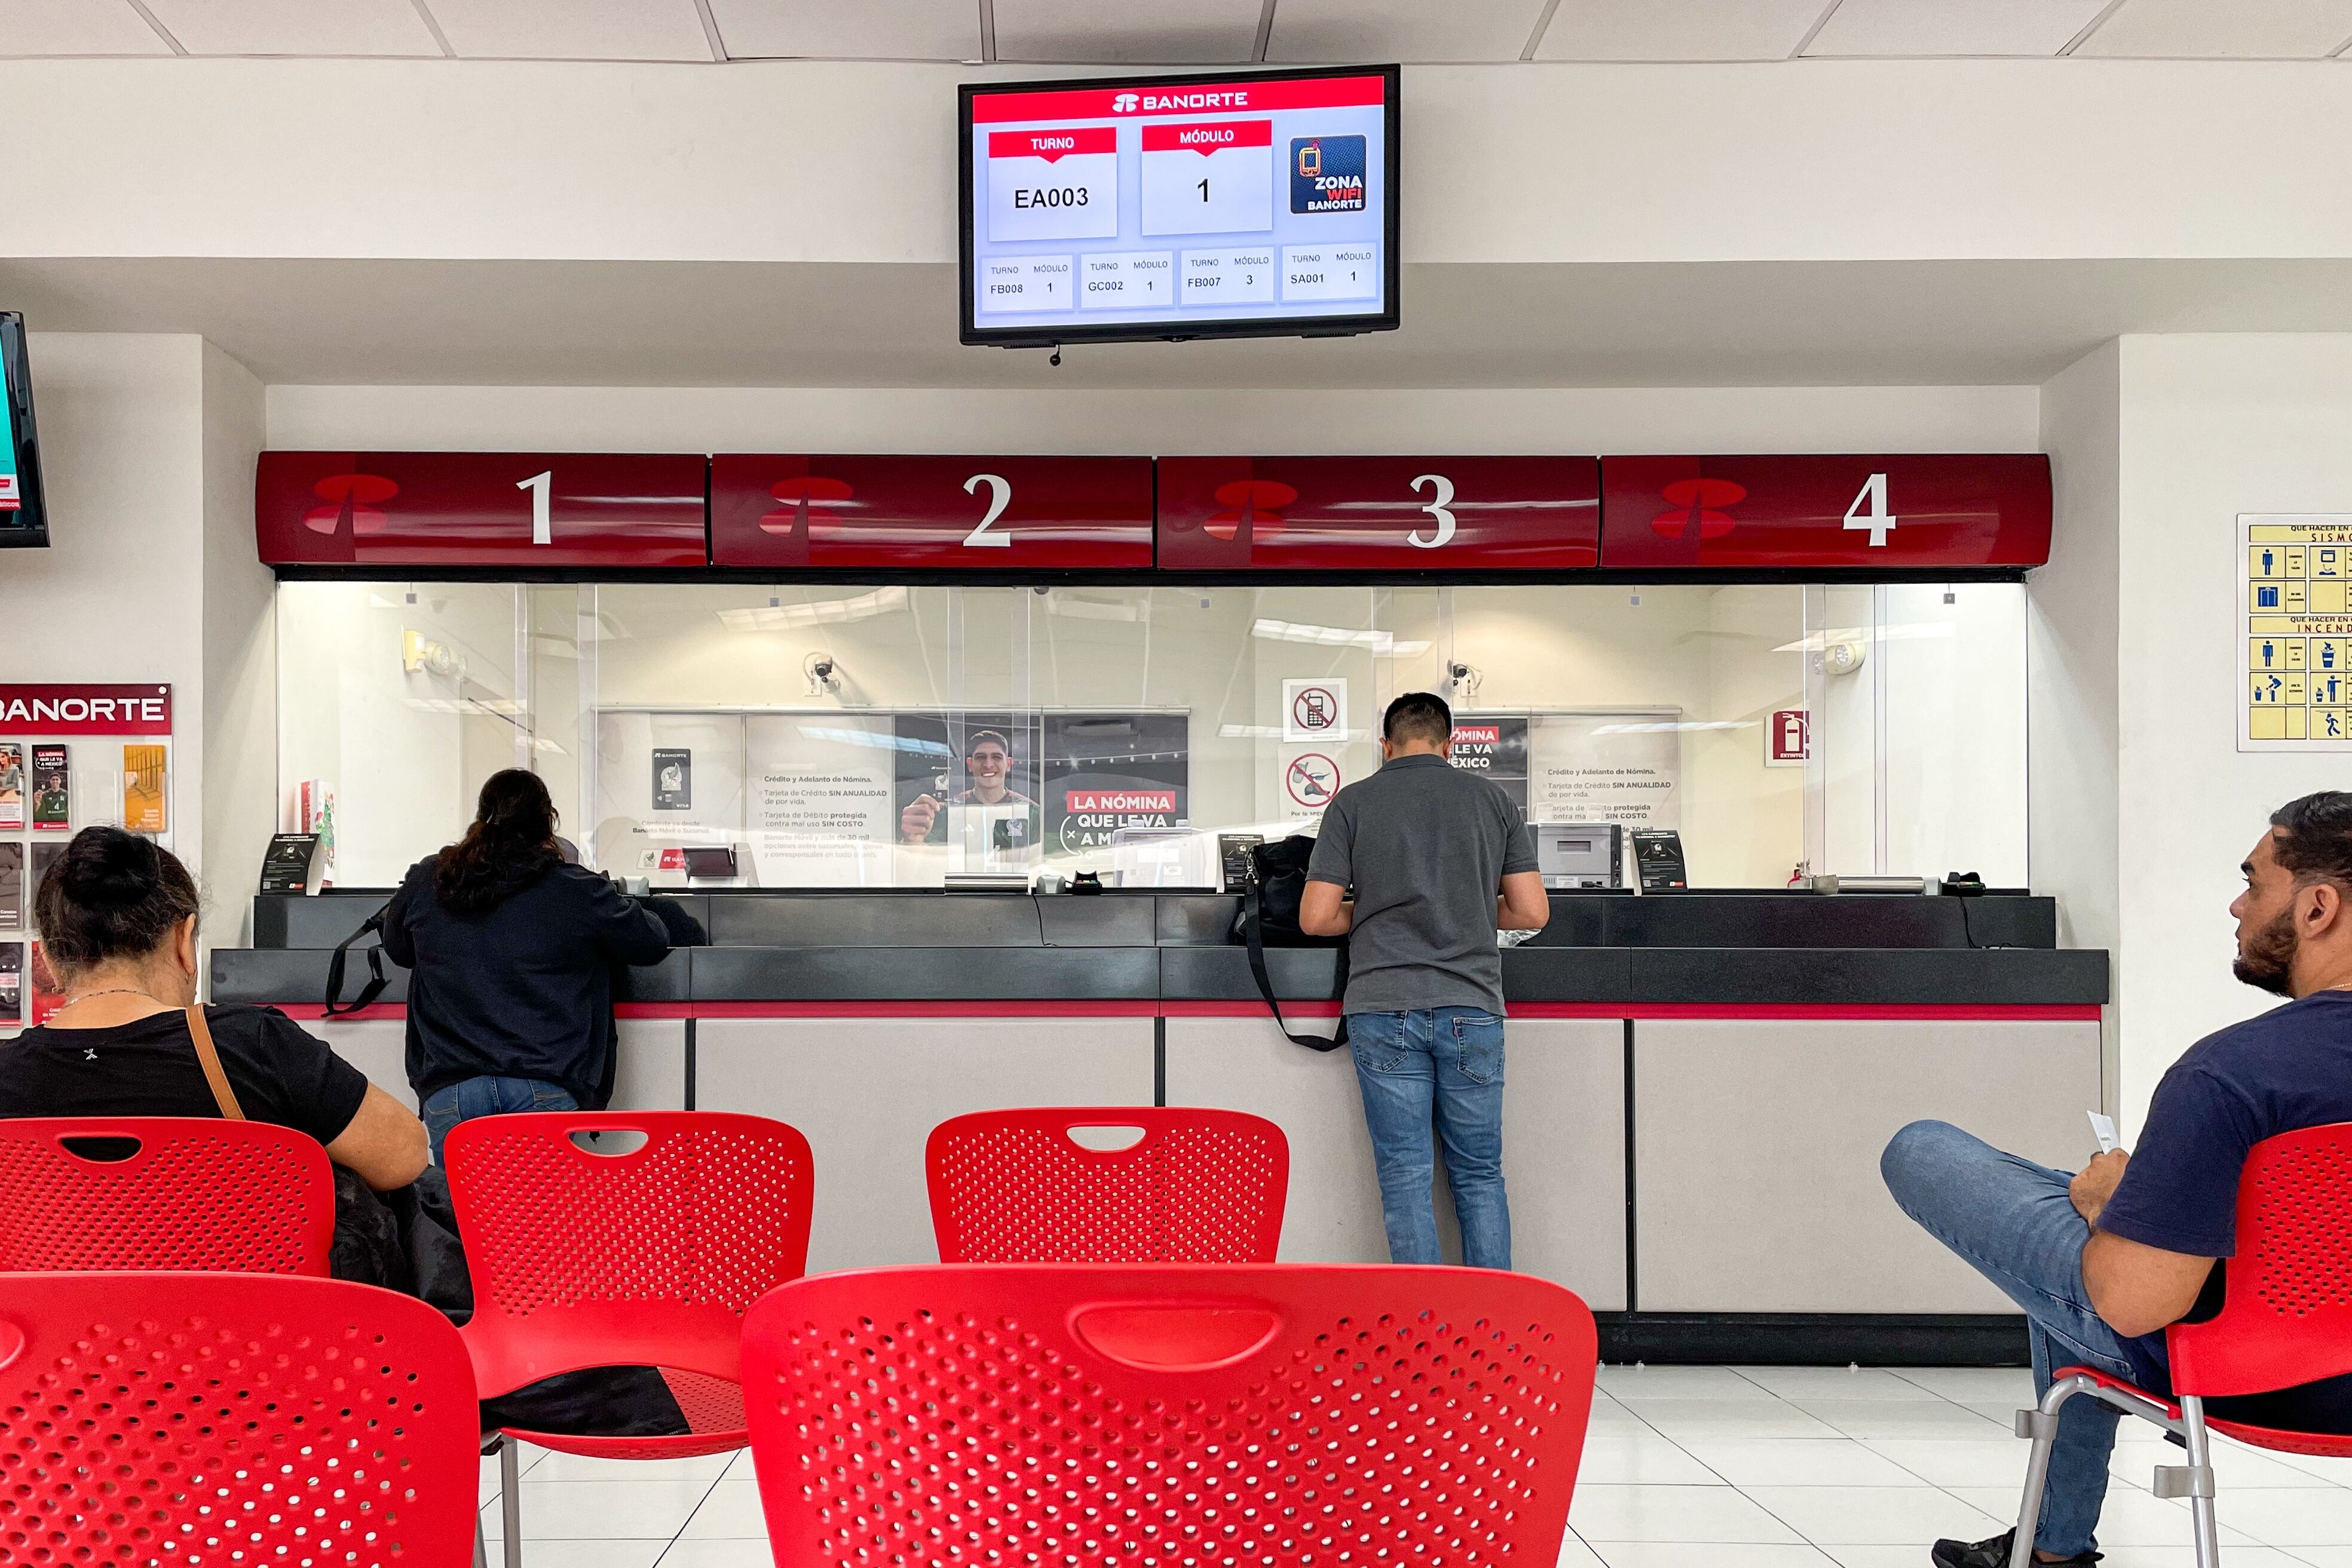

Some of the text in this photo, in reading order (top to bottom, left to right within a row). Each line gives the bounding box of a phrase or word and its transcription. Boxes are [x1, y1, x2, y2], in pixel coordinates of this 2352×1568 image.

[1143, 91, 1248, 110] BANORTE
[1180, 128, 1234, 144] MÓDULO
[1030, 137, 1074, 150] TURNO
[1315, 175, 1362, 190] ZONA
[1197, 178, 1209, 202] 1
[1327, 188, 1362, 200] WIFI
[1015, 187, 1089, 209] EA003
[1307, 199, 1362, 210] BANORTE
[1191, 256, 1269, 267] TURNO MÓDULO
[1292, 252, 1371, 263] TURNO MÓDULO
[1033, 264, 1068, 273] MÓDULO
[1134, 261, 1168, 269] MÓDULO
[1188, 274, 1253, 287] FB007 3
[1290, 271, 1356, 284] SA001 1
[990, 283, 1052, 294] FB008 1
[1088, 281, 1153, 291] GC002 1
[516, 471, 551, 544] 1
[963, 474, 1010, 546] 2
[1407, 475, 1456, 548] 3
[1843, 474, 1896, 546] 4
[0, 699, 164, 721] ANORTE
[1450, 728, 1495, 741] ÓMINA
[1454, 744, 1493, 754] LE VA
[1448, 755, 1490, 768] ÉXICO
[1074, 793, 1171, 810] LA NÓMINA
[1077, 814, 1113, 827] QUE
[1141, 814, 1167, 827] VA
[1080, 832, 1094, 845] A
